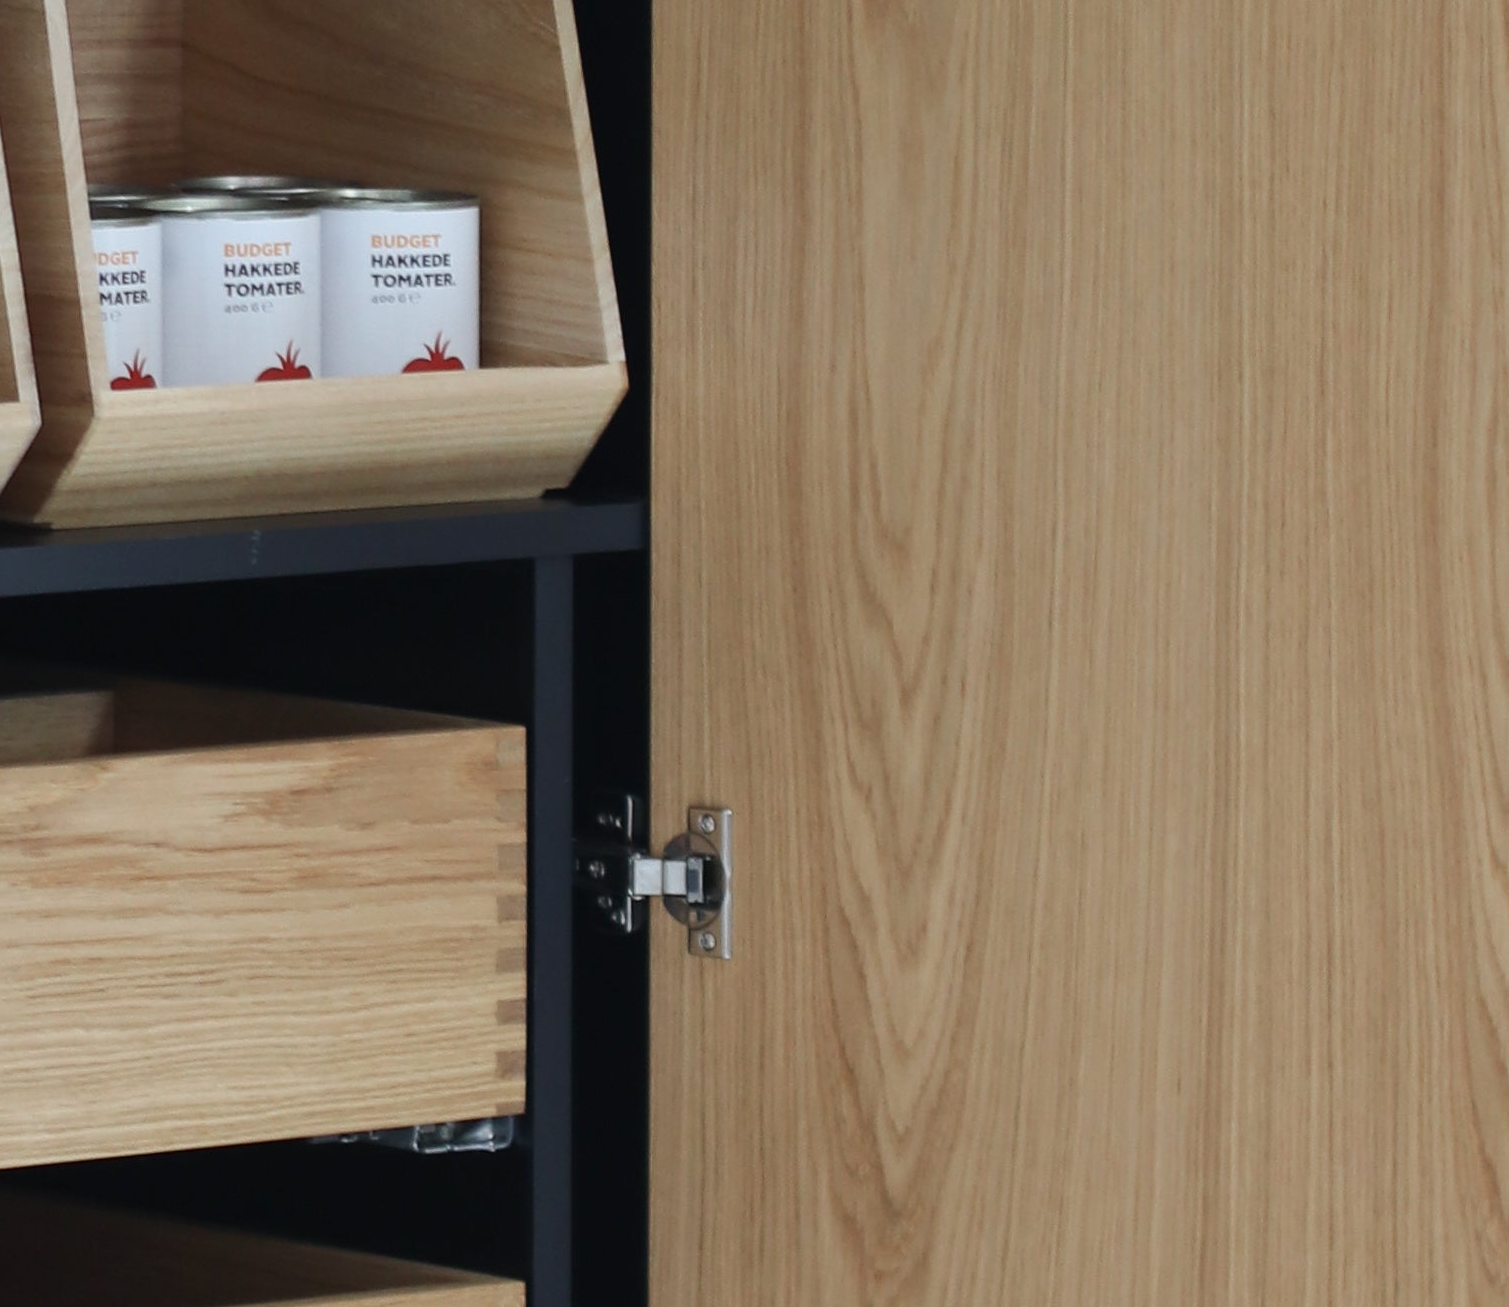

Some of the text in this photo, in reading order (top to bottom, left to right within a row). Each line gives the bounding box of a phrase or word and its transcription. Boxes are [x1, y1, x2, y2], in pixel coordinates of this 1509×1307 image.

[371, 234, 442, 249] BUDGET
[224, 242, 292, 257] BUDGET
[371, 253, 451, 268] HAKKEDE
[224, 262, 300, 277] HAKKEDE
[371, 273, 456, 288] TOMATER.
[224, 281, 305, 297] TOMATER.
